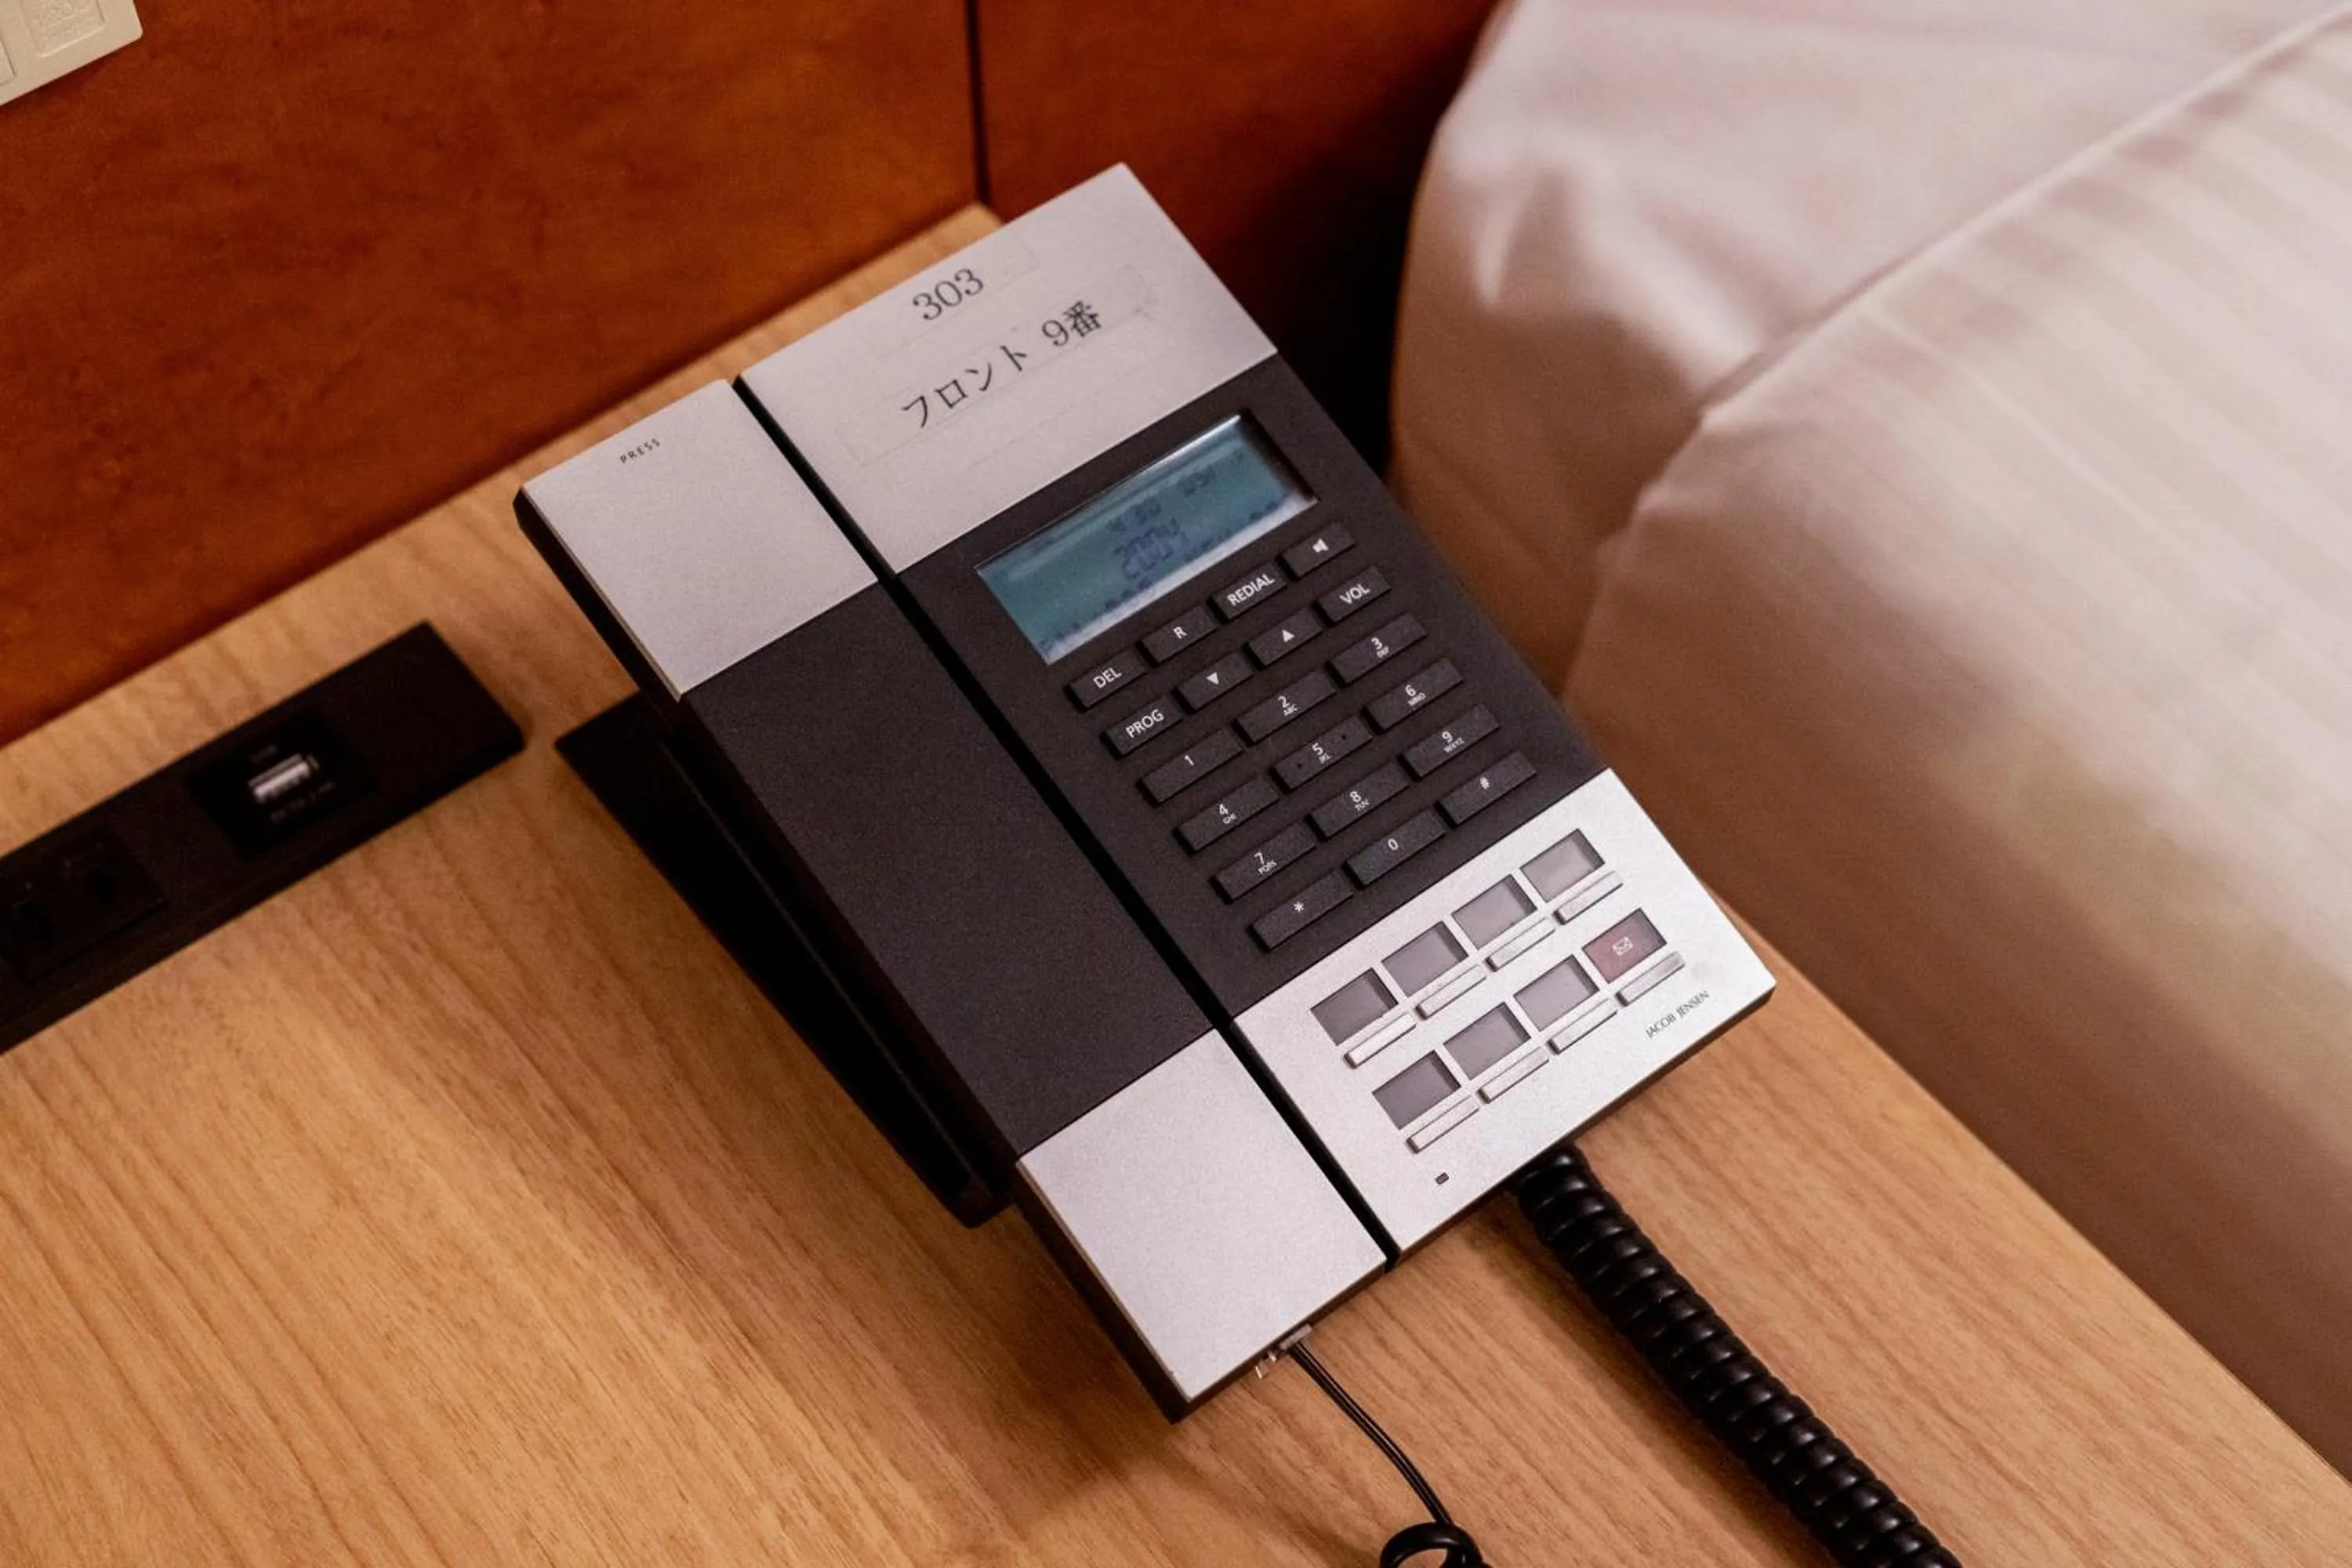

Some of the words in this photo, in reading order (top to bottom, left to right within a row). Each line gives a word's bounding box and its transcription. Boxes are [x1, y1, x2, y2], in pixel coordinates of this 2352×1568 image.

[913, 268, 985, 321] 303
[902, 345, 1027, 428] フロント
[1041, 300, 1102, 347] 9番
[619, 438, 661, 464] PRESS
[1227, 573, 1276, 607] REDIAL
[1339, 583, 1370, 604] VOL
[1174, 626, 1188, 640] R
[1371, 637, 1383, 650] 3
[1093, 666, 1123, 688] DEL
[1405, 684, 1416, 696] 6
[1278, 695, 1290, 708] 2
[1125, 709, 1164, 738] PROG
[1442, 731, 1453, 743] 9
[1312, 742, 1323, 755] 5
[1185, 754, 1194, 767] 1
[1349, 791, 1362, 803] 8
[1219, 804, 1229, 815] 4
[1254, 852, 1265, 865] 7
